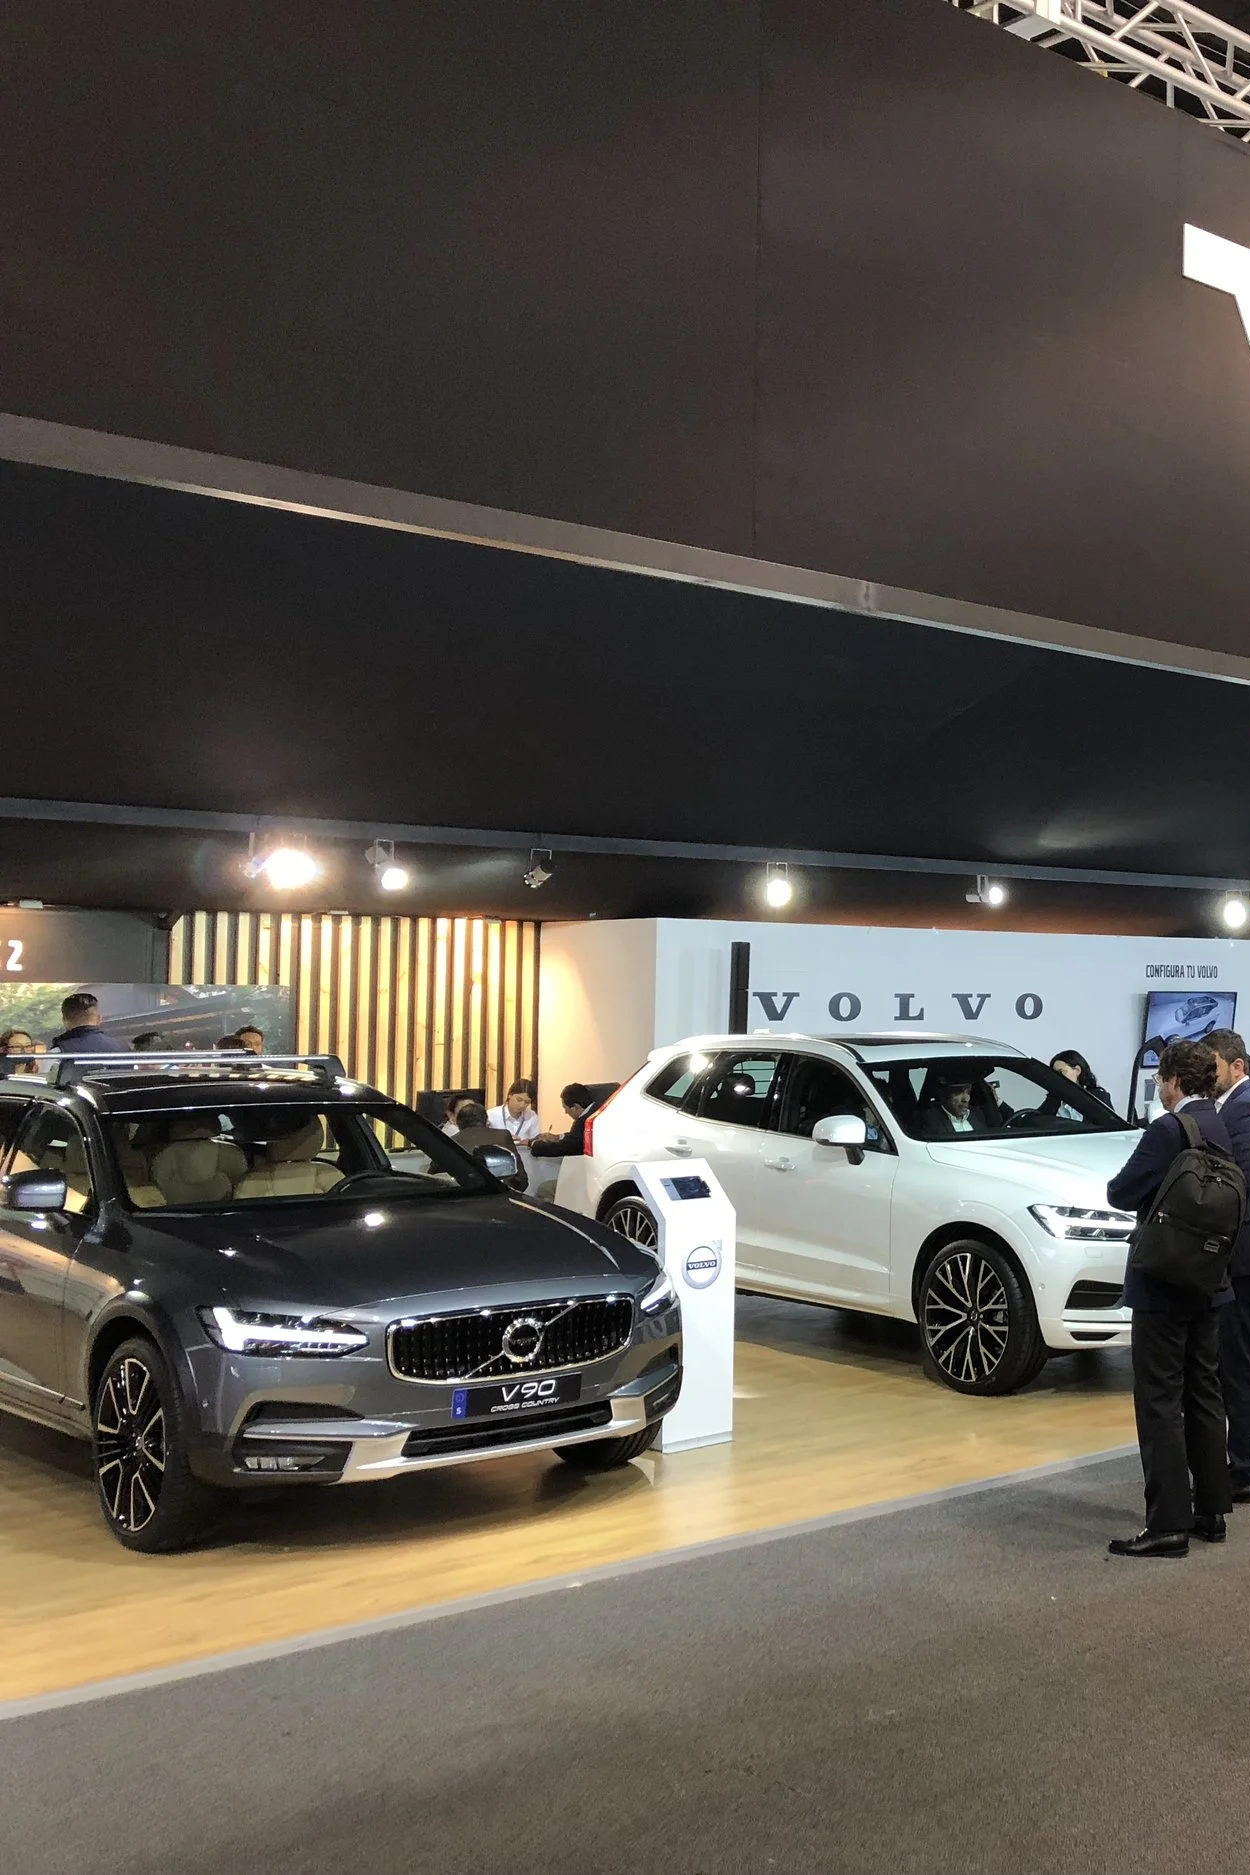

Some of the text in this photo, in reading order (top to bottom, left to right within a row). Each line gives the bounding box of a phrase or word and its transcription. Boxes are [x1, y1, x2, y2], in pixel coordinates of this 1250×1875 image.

[6, 939, 24, 972] 2
[1145, 964, 1218, 979] CONFIGURA TU VOLVO
[752, 991, 1043, 1022] VOLVO
[687, 1260, 716, 1270] VOLVO
[501, 1379, 556, 1402] V90
[456, 1406, 462, 1415] S
[490, 1396, 560, 1413] CROSS COUNTRY
